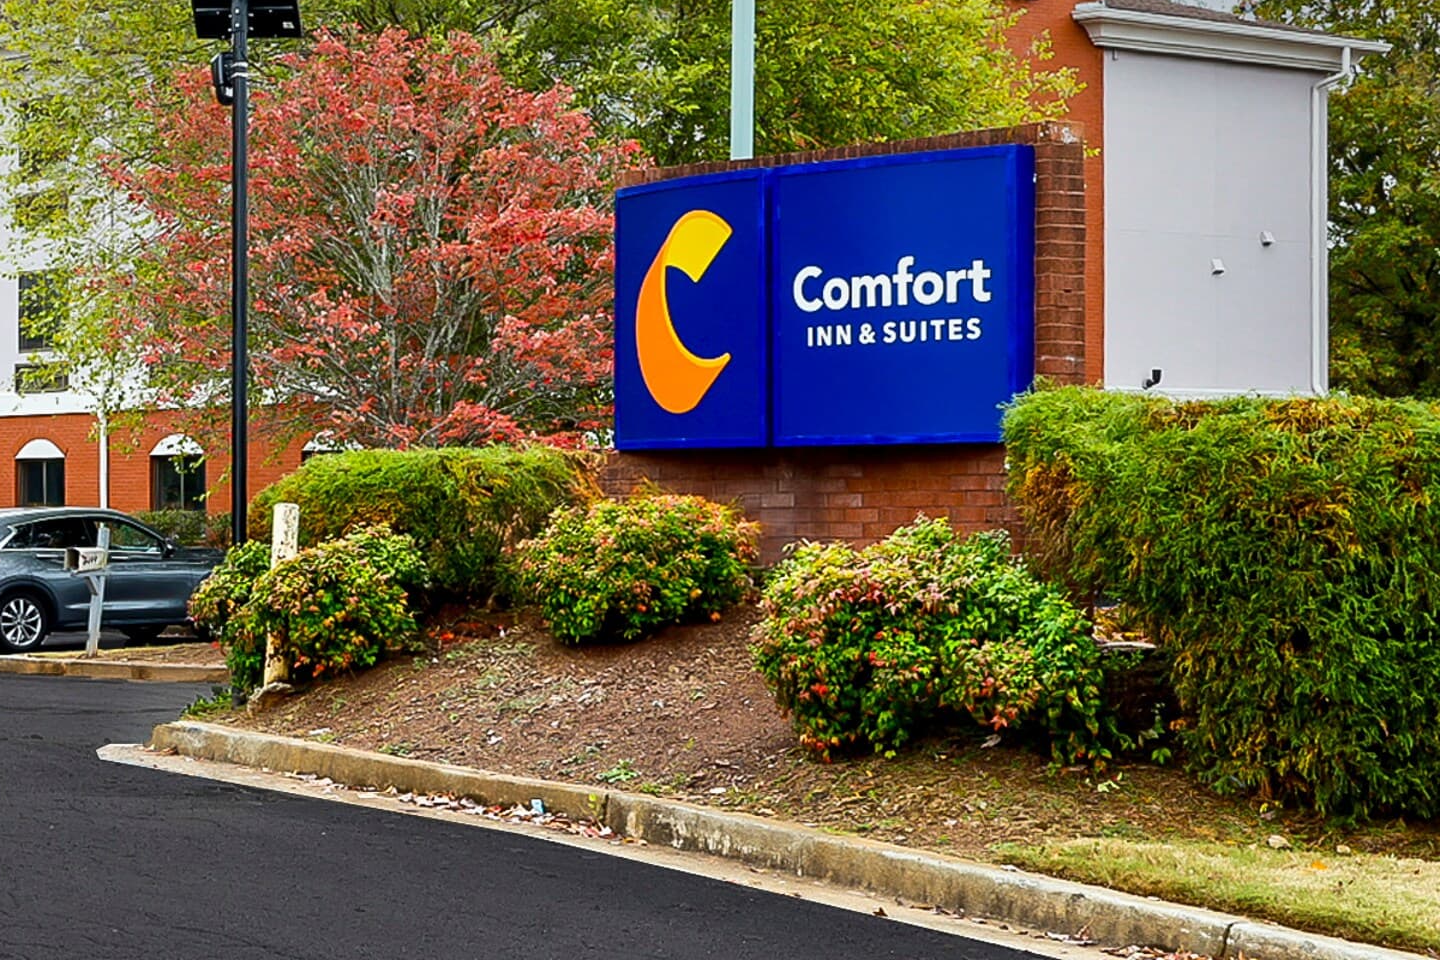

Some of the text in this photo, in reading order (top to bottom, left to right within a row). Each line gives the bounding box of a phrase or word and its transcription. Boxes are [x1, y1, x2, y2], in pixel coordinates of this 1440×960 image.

[793, 255, 992, 312] Comfort
[807, 317, 982, 347] INN & SUITES
